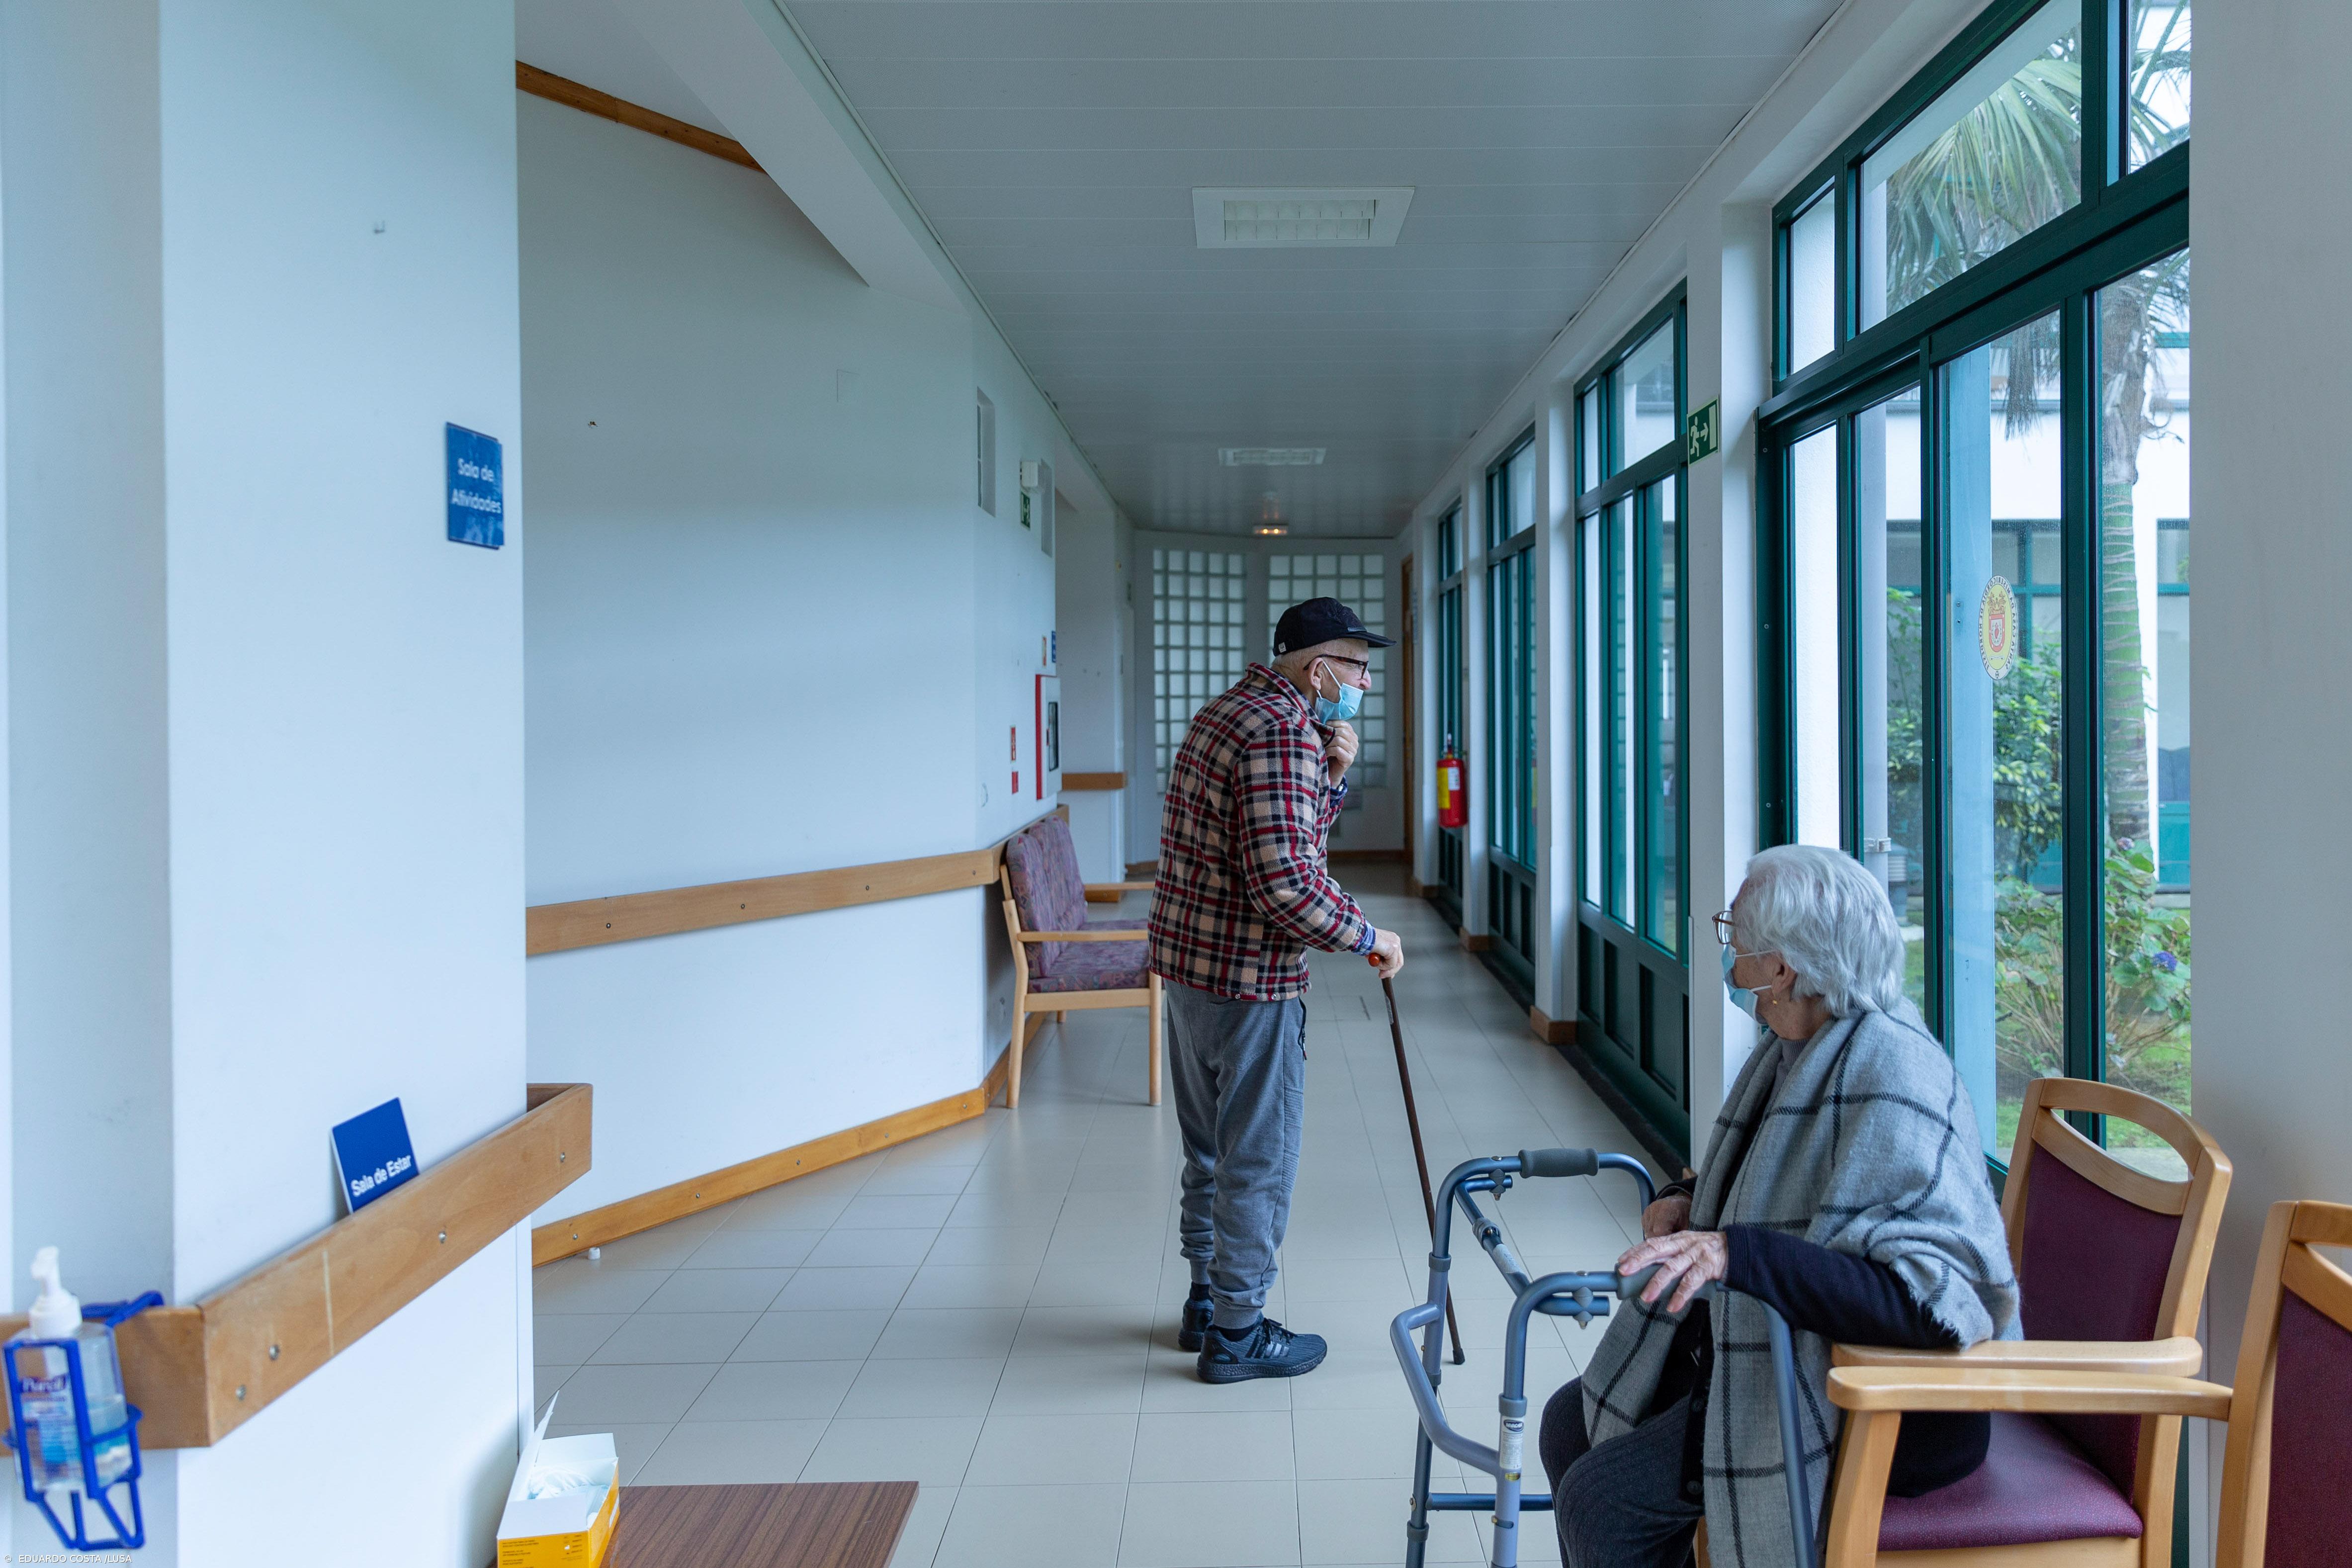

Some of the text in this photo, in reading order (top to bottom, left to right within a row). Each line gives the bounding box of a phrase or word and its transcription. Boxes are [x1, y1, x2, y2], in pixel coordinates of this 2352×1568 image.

[457, 457, 494, 482] Sala de
[451, 488, 502, 514] Atividades
[351, 1155, 412, 1197] Sala de Estar
